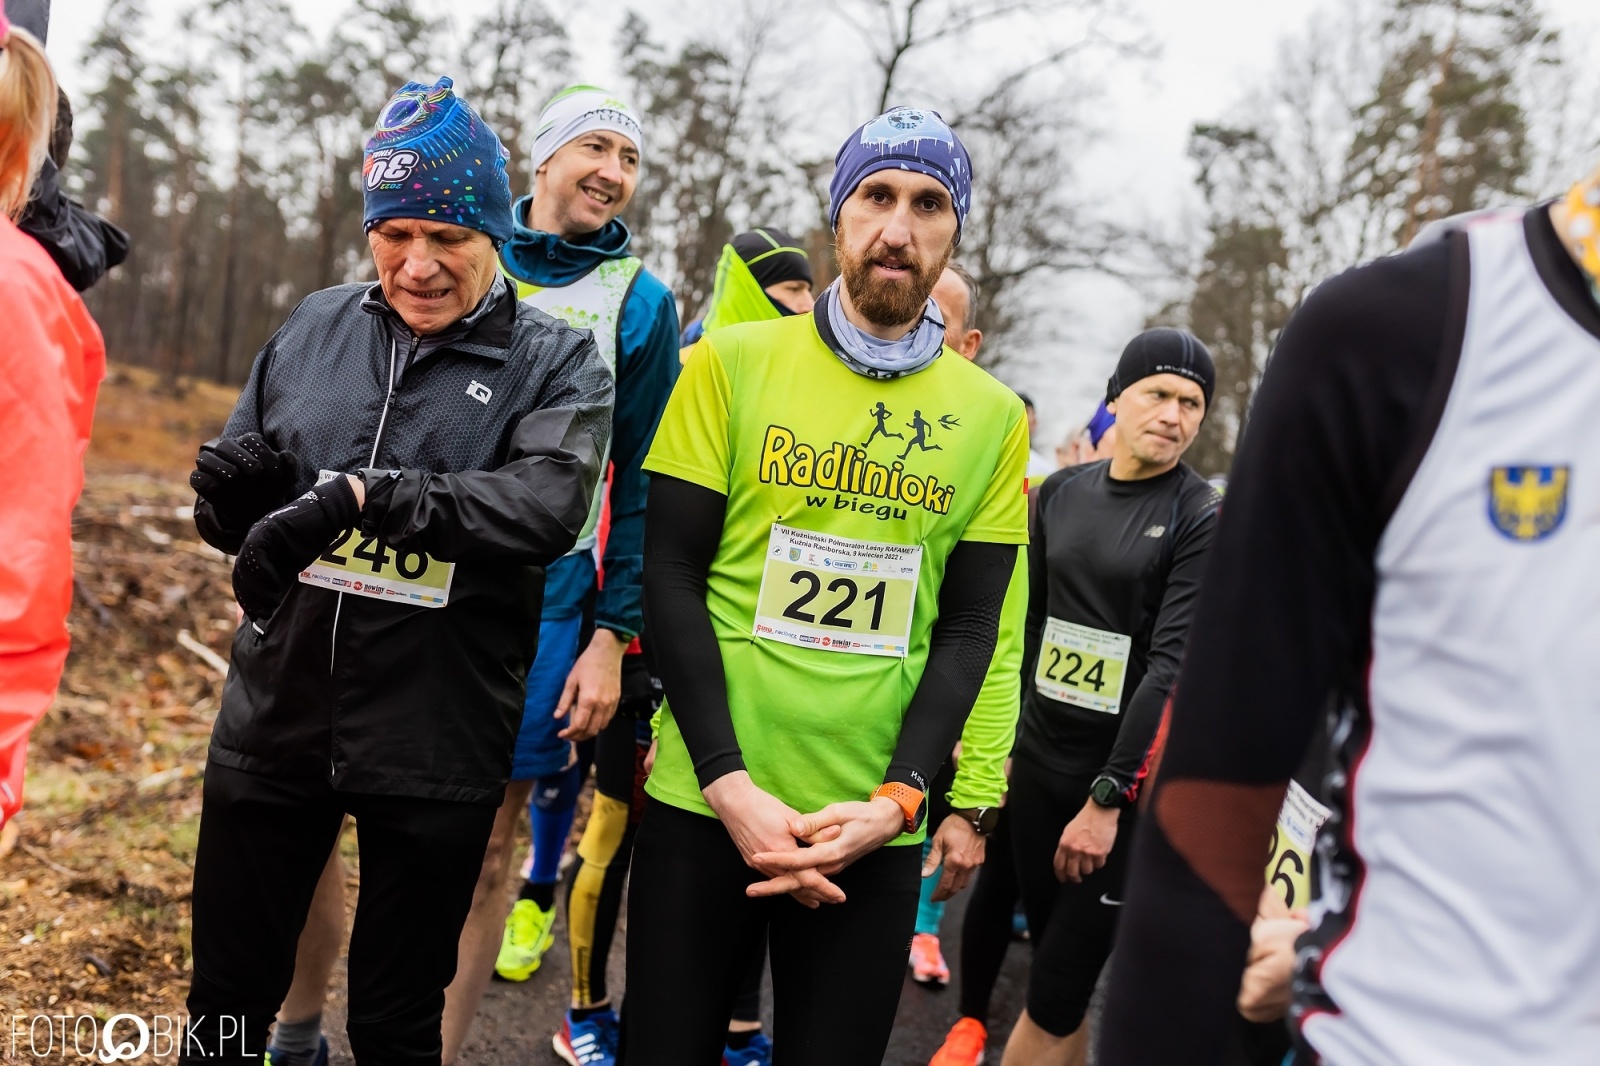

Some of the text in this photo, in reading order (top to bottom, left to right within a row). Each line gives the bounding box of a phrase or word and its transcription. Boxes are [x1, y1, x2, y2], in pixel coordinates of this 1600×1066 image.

[367, 150, 419, 191] 30
[759, 424, 956, 515] Radlinioki
[805, 494, 908, 520] w biegu
[781, 527, 790, 536] VII
[885, 546, 914, 554] RAFAMET
[884, 552, 899, 560] 2022
[782, 570, 886, 631] 221
[1045, 647, 1105, 692] 224
